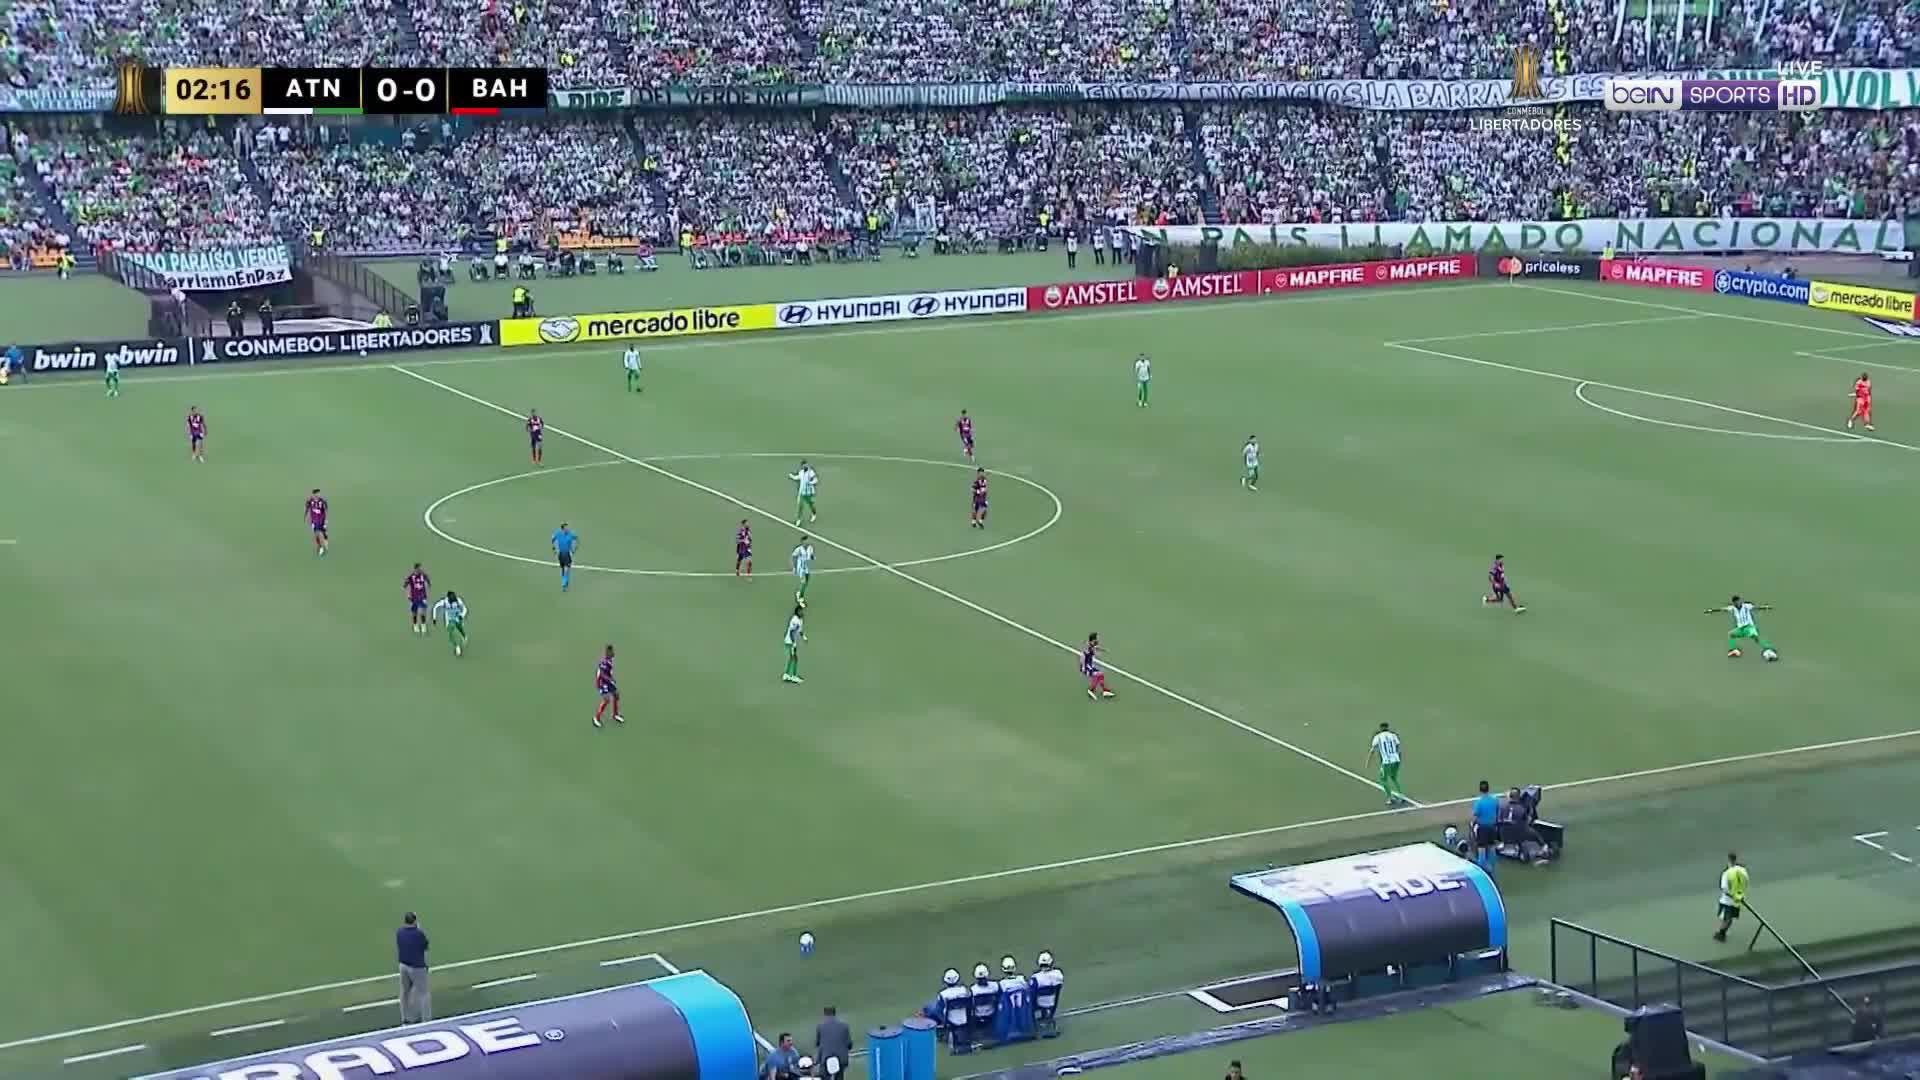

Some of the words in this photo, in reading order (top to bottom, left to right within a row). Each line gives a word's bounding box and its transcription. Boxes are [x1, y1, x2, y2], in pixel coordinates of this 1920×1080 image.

[920, 83, 1006, 105] VERDOLAGA
[1366, 80, 1400, 107] LA
[1407, 82, 1505, 109] BARRA
[1616, 220, 1899, 251] NACIONAL
[238, 245, 288, 267] VERDE
[1290, 267, 1363, 288] MAPFRE
[1390, 258, 1460, 280] MAPFRE
[1626, 264, 1703, 287] MAPFRE
[1065, 282, 1137, 305] AMSTEL
[1172, 273, 1242, 297] AMSTEL
[1732, 276, 1809, 301] crypto.com
[816, 300, 899, 320] HYUNDAI
[945, 292, 1024, 312] HYUNDAI
[1831, 291, 1884, 308] mercado
[1886, 295, 1912, 312] libre
[588, 316, 687, 337] mercado
[692, 311, 739, 330] libre
[119, 341, 178, 365] bwin
[225, 337, 336, 358] CONMEBOL
[340, 327, 472, 351] LIBERTADORES
[34, 346, 97, 370] bwin
